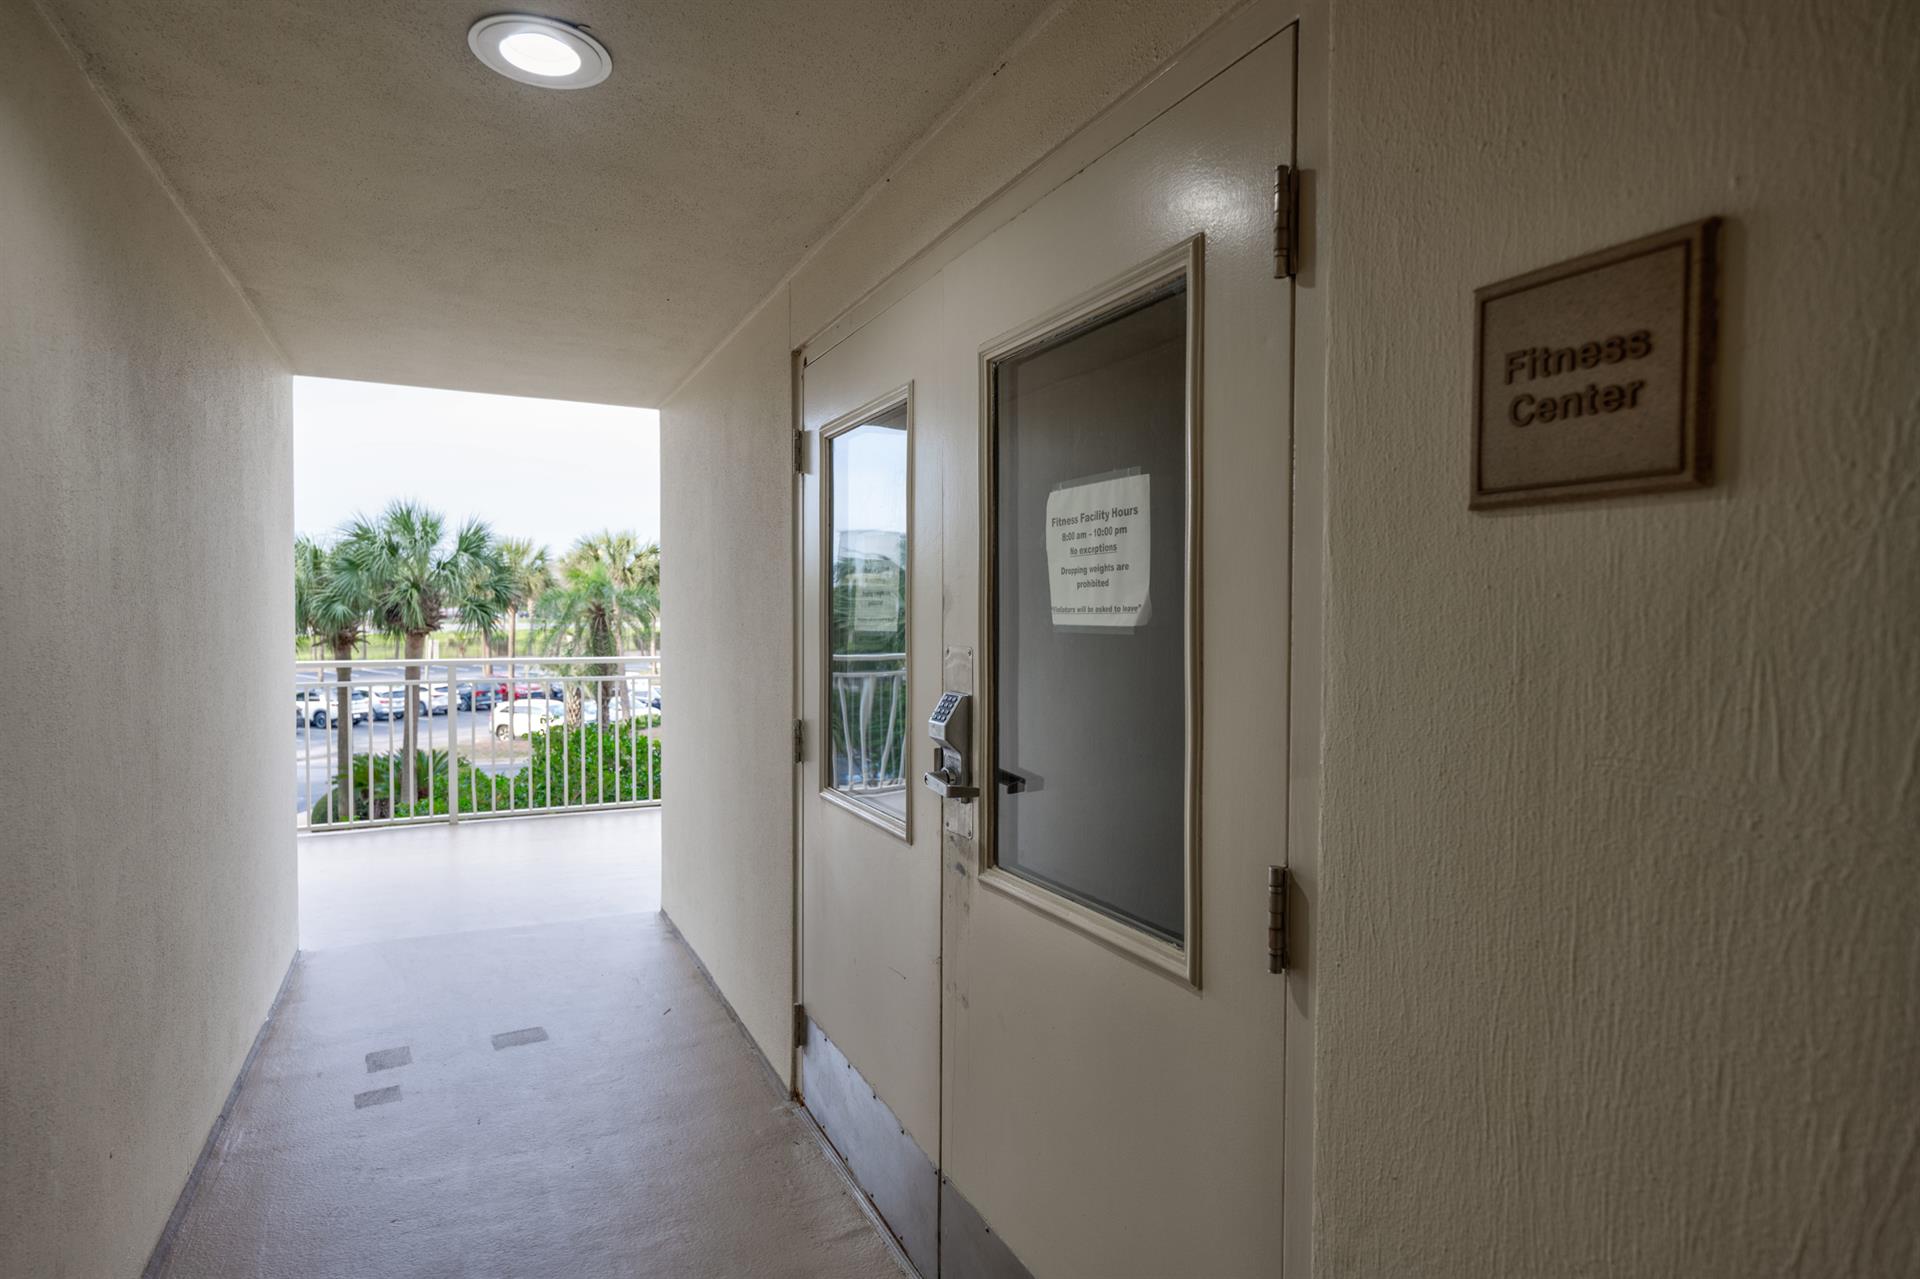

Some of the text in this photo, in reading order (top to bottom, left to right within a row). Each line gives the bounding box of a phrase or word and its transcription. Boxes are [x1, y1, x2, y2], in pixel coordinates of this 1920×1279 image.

[1504, 329, 1654, 385] Fitness
[1508, 379, 1646, 428] Center
[1051, 506, 1139, 527] Fitness Facility Hours
[1076, 531, 1087, 540] am
[1094, 526, 1113, 537] 10:00
[1114, 526, 1128, 537] pm
[1070, 543, 1117, 555] No exceptions
[1060, 563, 1130, 576] Dropping weights are
[1076, 578, 1110, 590] prohibited
[1114, 605, 1121, 613] to
